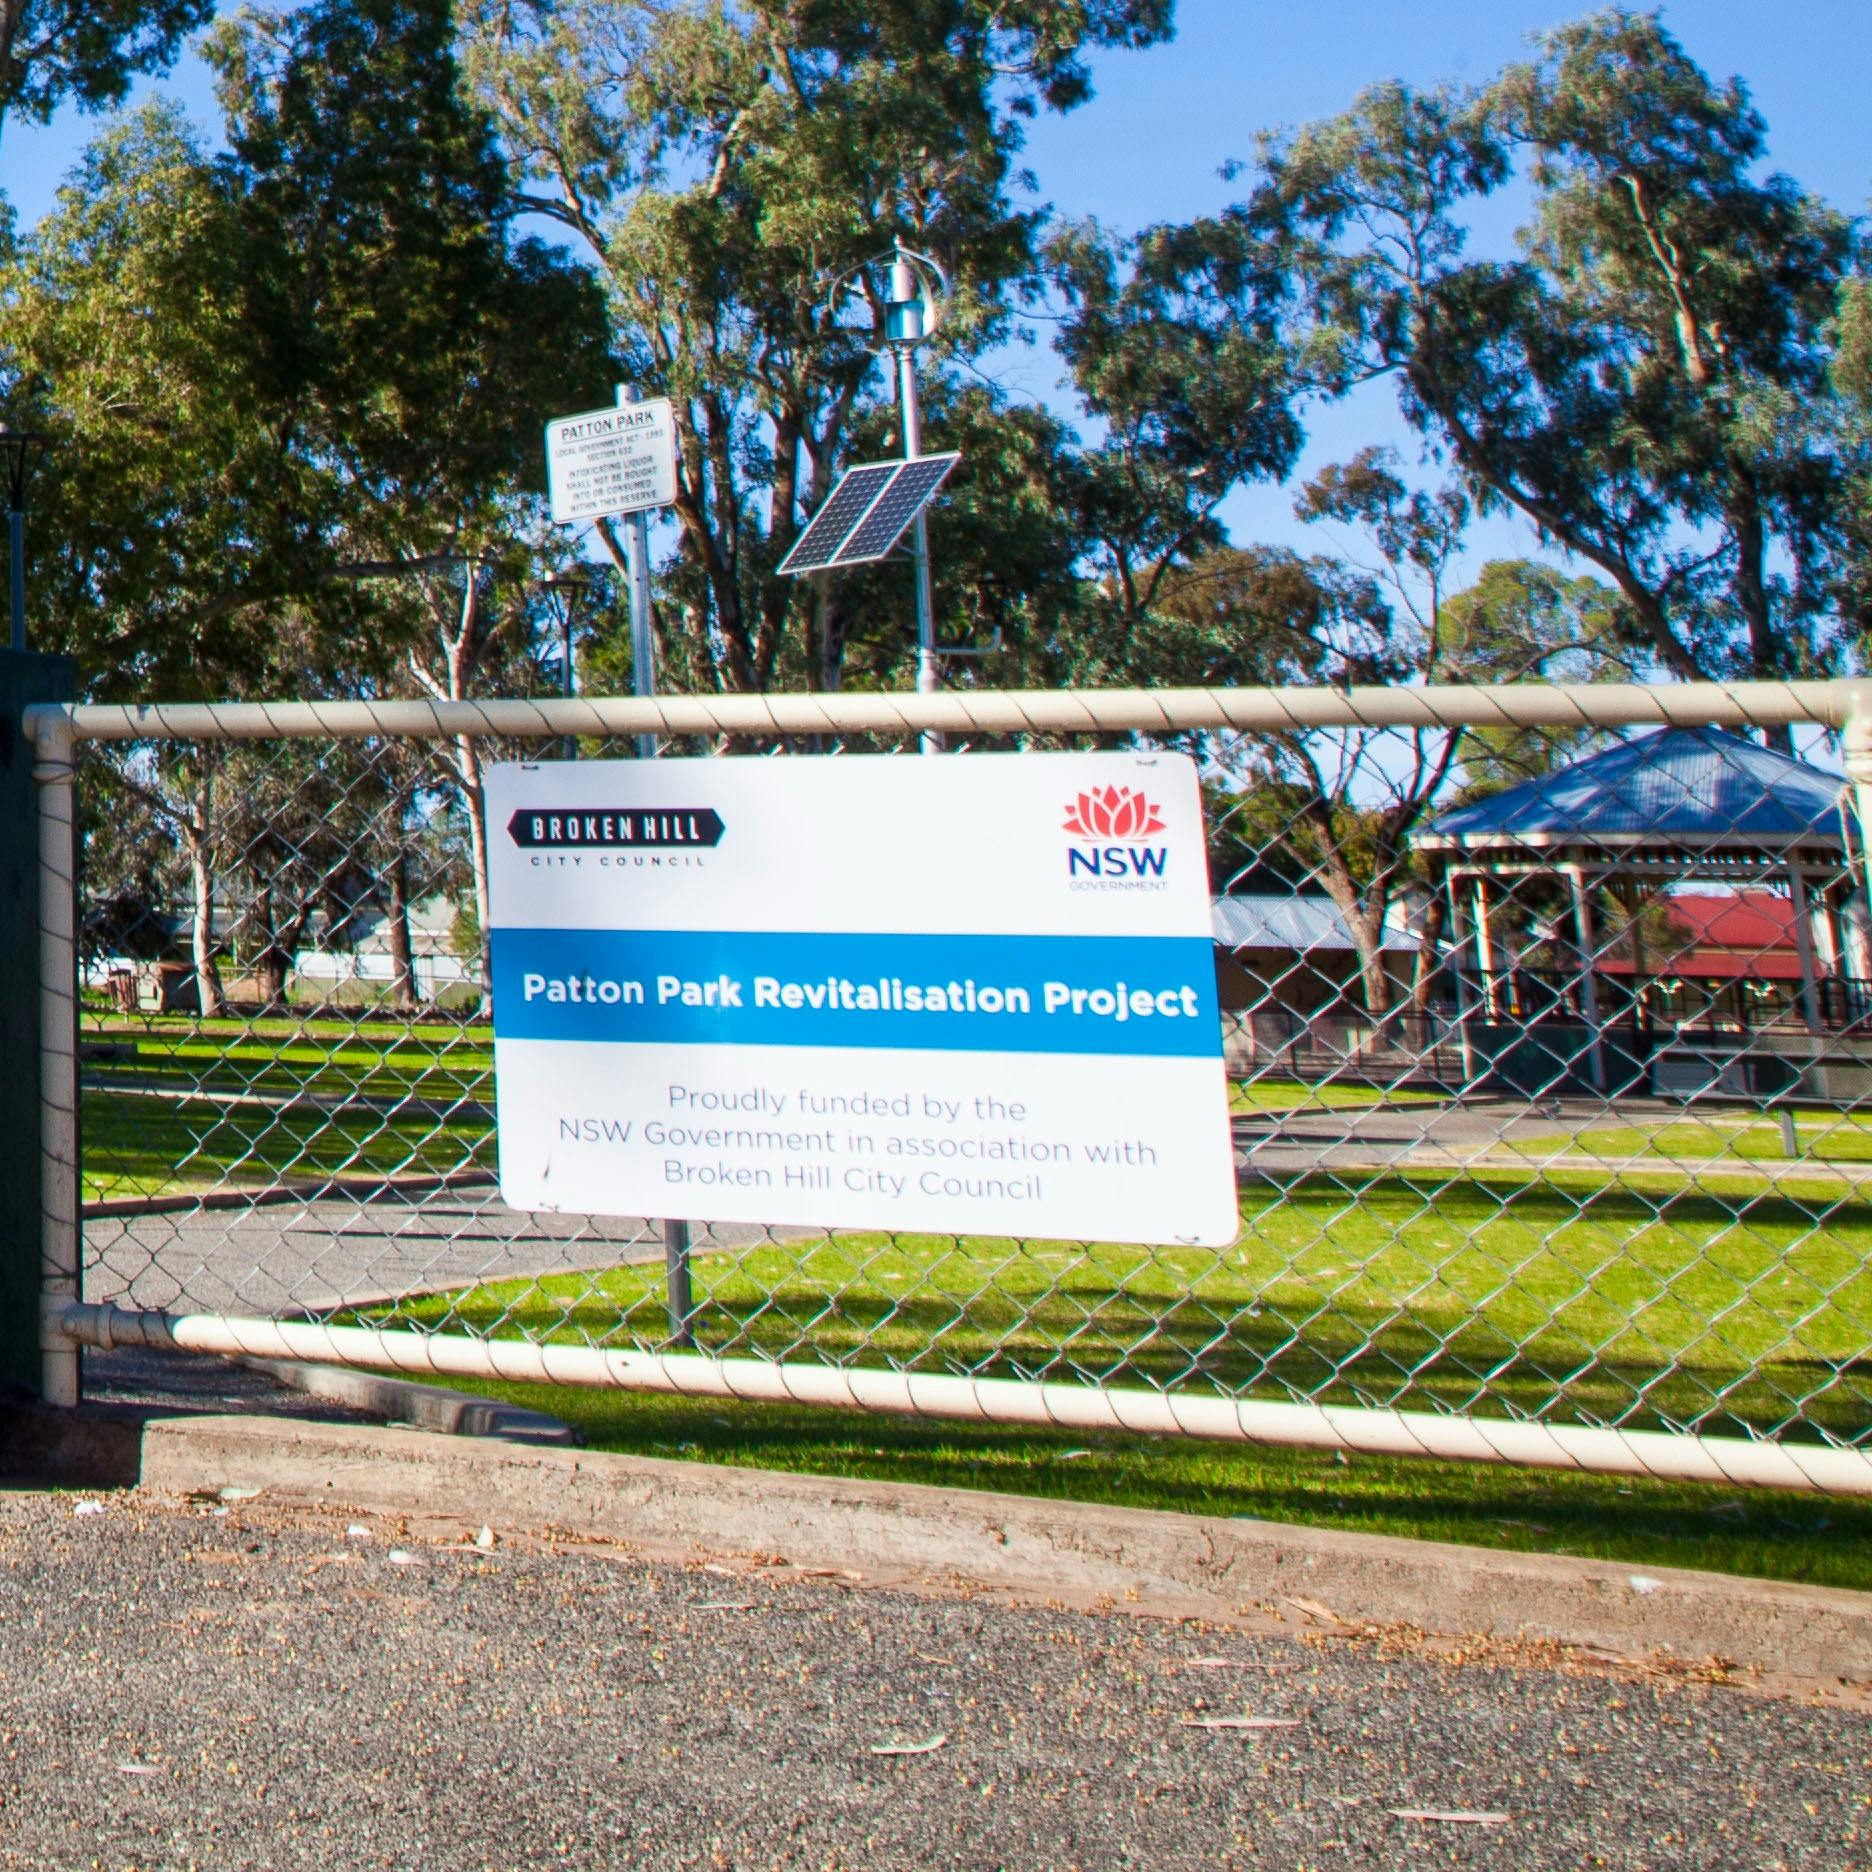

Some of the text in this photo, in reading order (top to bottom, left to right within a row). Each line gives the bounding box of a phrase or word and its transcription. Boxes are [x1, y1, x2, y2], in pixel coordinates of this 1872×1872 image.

[561, 410, 654, 440] PATTON PARK
[555, 447, 577, 458] LOCAL
[578, 437, 624, 454] GOVERNMENT
[587, 450, 616, 462] SECTION
[569, 455, 653, 478] INTOXICATING LIQUOR
[607, 479, 652, 495] CONSUMED
[569, 489, 657, 512] WITHIN THIS RESERVE
[532, 815, 700, 840] BROKEN HILL
[530, 856, 705, 867] CITY COUNCIL
[1068, 847, 1167, 877] NSW
[1069, 880, 1168, 892] GOVERNMENT
[523, 973, 1200, 1022] Patton Park Revitalisation Project
[668, 1085, 1027, 1124] Proudly funded by the
[559, 1117, 1157, 1165] NSW Government in association with
[663, 1159, 1043, 1200] Broken Hill City Council
